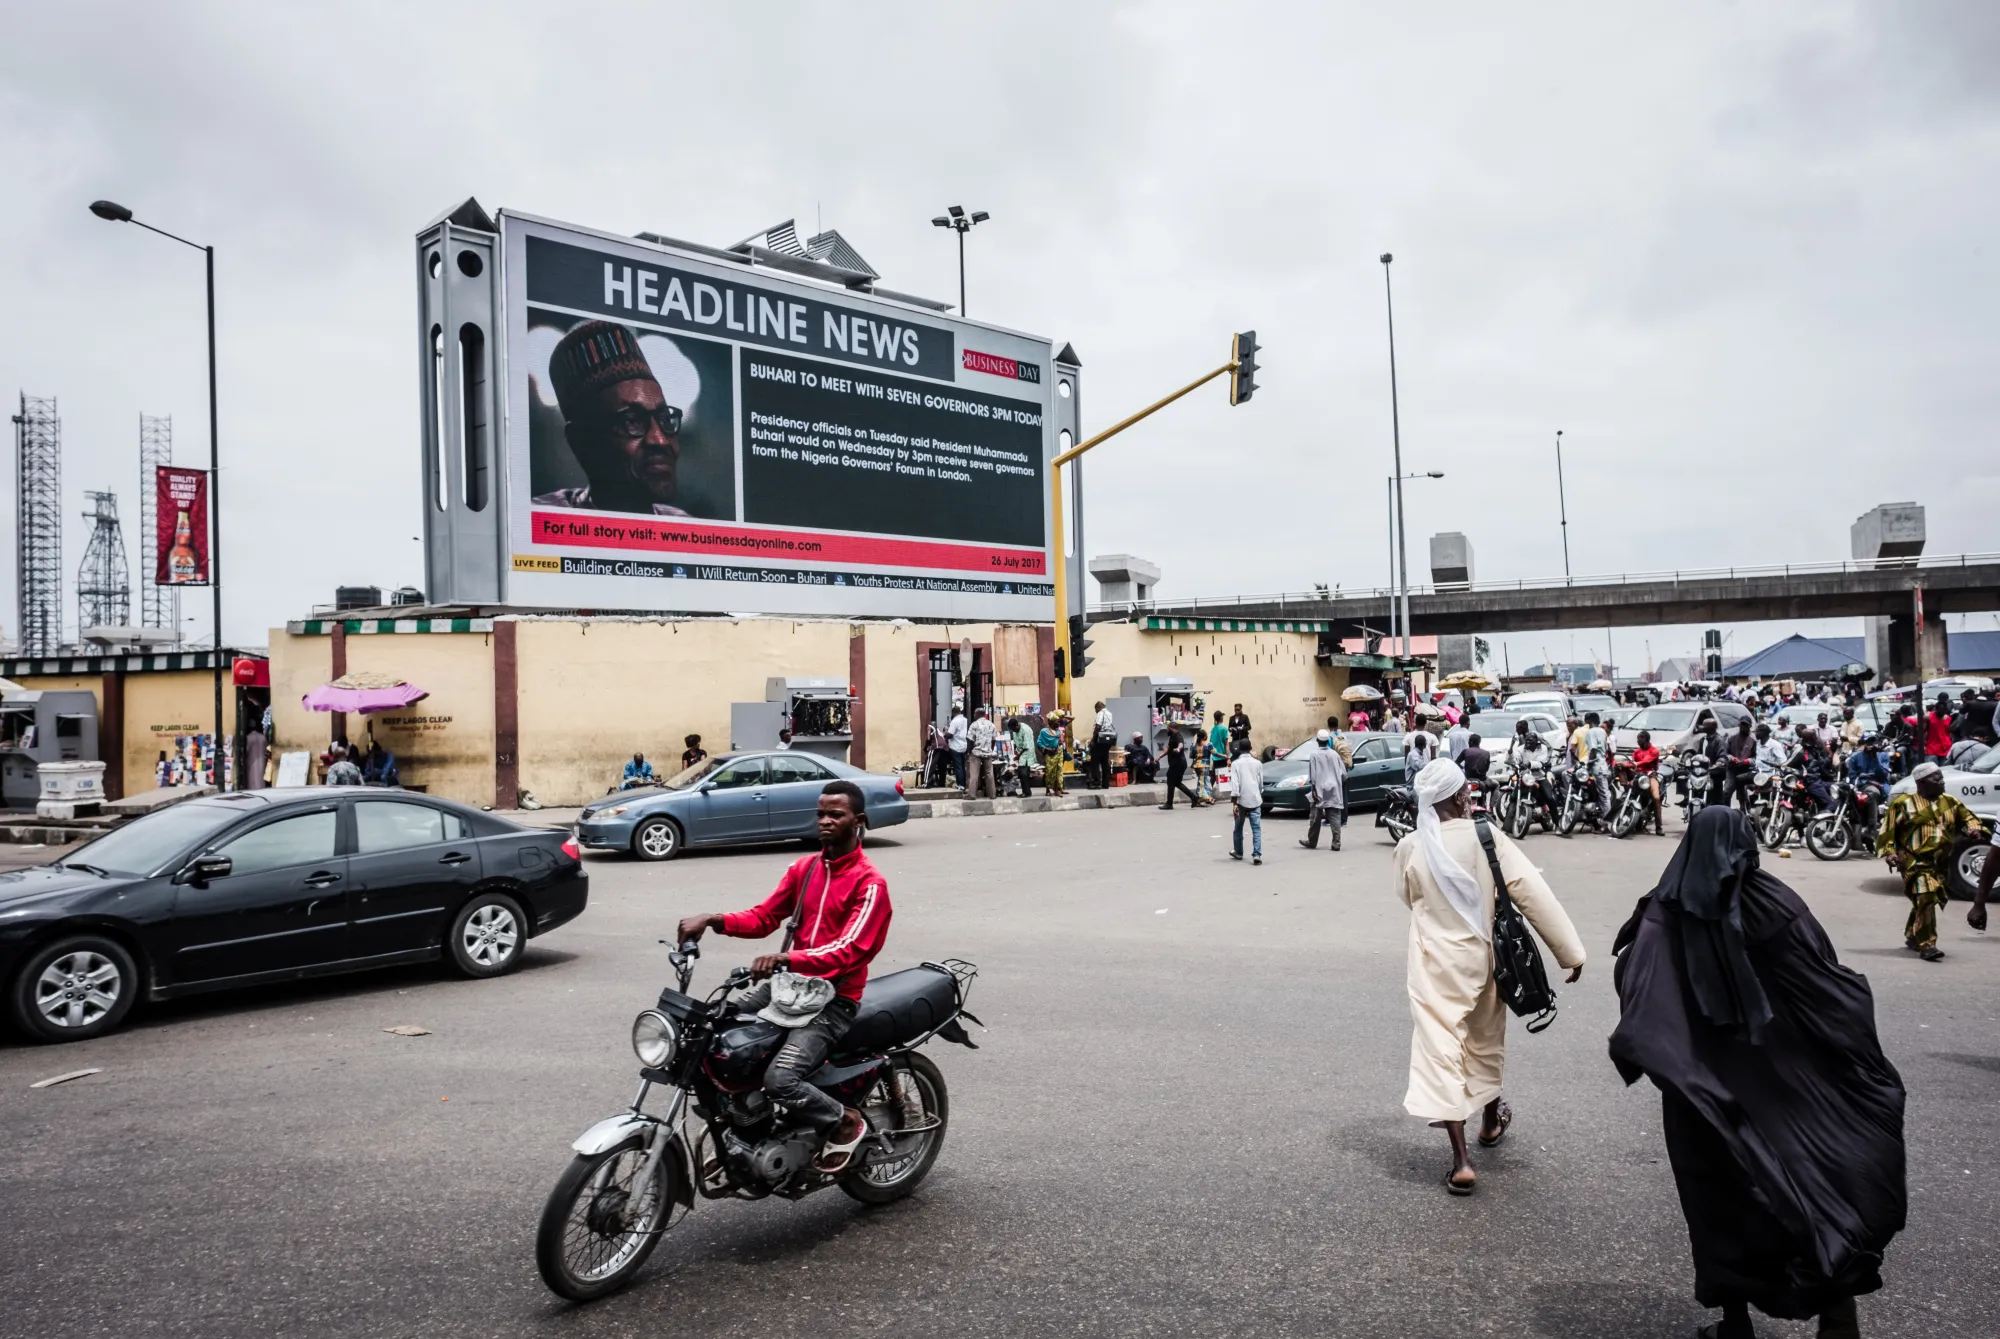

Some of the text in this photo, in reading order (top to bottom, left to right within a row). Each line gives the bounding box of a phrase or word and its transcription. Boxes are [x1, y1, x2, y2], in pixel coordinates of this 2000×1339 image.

[604, 262, 920, 366] HEADLINE NEWS
[966, 353, 1039, 380] BUSINESS DAY
[750, 363, 1042, 426] BUHARI TO MEET WITH SEVEN GOVERNORS 3PM TODAY
[751, 412, 1028, 462] Presidency officials on Tuesday said President Muhammadu
[751, 427, 1035, 476] Buhari would on Wednesday by 3pm receive seven governors
[752, 444, 972, 482] from the Nigeria Governors' Forum in London.
[170, 475, 196, 484] QUALITY
[170, 483, 196, 492] ALWAYS
[170, 491, 196, 500] STANDS
[177, 500, 190, 508] OUT
[544, 520, 822, 552] For full story visit: www.businessdayonline.com
[514, 559, 534, 568] LIVE
[537, 560, 558, 569] FEED
[564, 560, 612, 575] Building
[615, 562, 664, 577] Collapse
[696, 567, 699, 579] I
[702, 567, 722, 580] Will
[725, 568, 759, 582] Return
[761, 570, 787, 583] Soon
[797, 571, 827, 585] Buhari
[853, 574, 882, 588] Youths
[884, 577, 914, 589] Protest
[916, 578, 926, 588] At
[926, 580, 959, 592] National
[961, 581, 998, 594] Assembly
[1018, 584, 1042, 595] United
[992, 556, 1041, 569] 26 July 2017
[1962, 786, 1986, 796] 004
